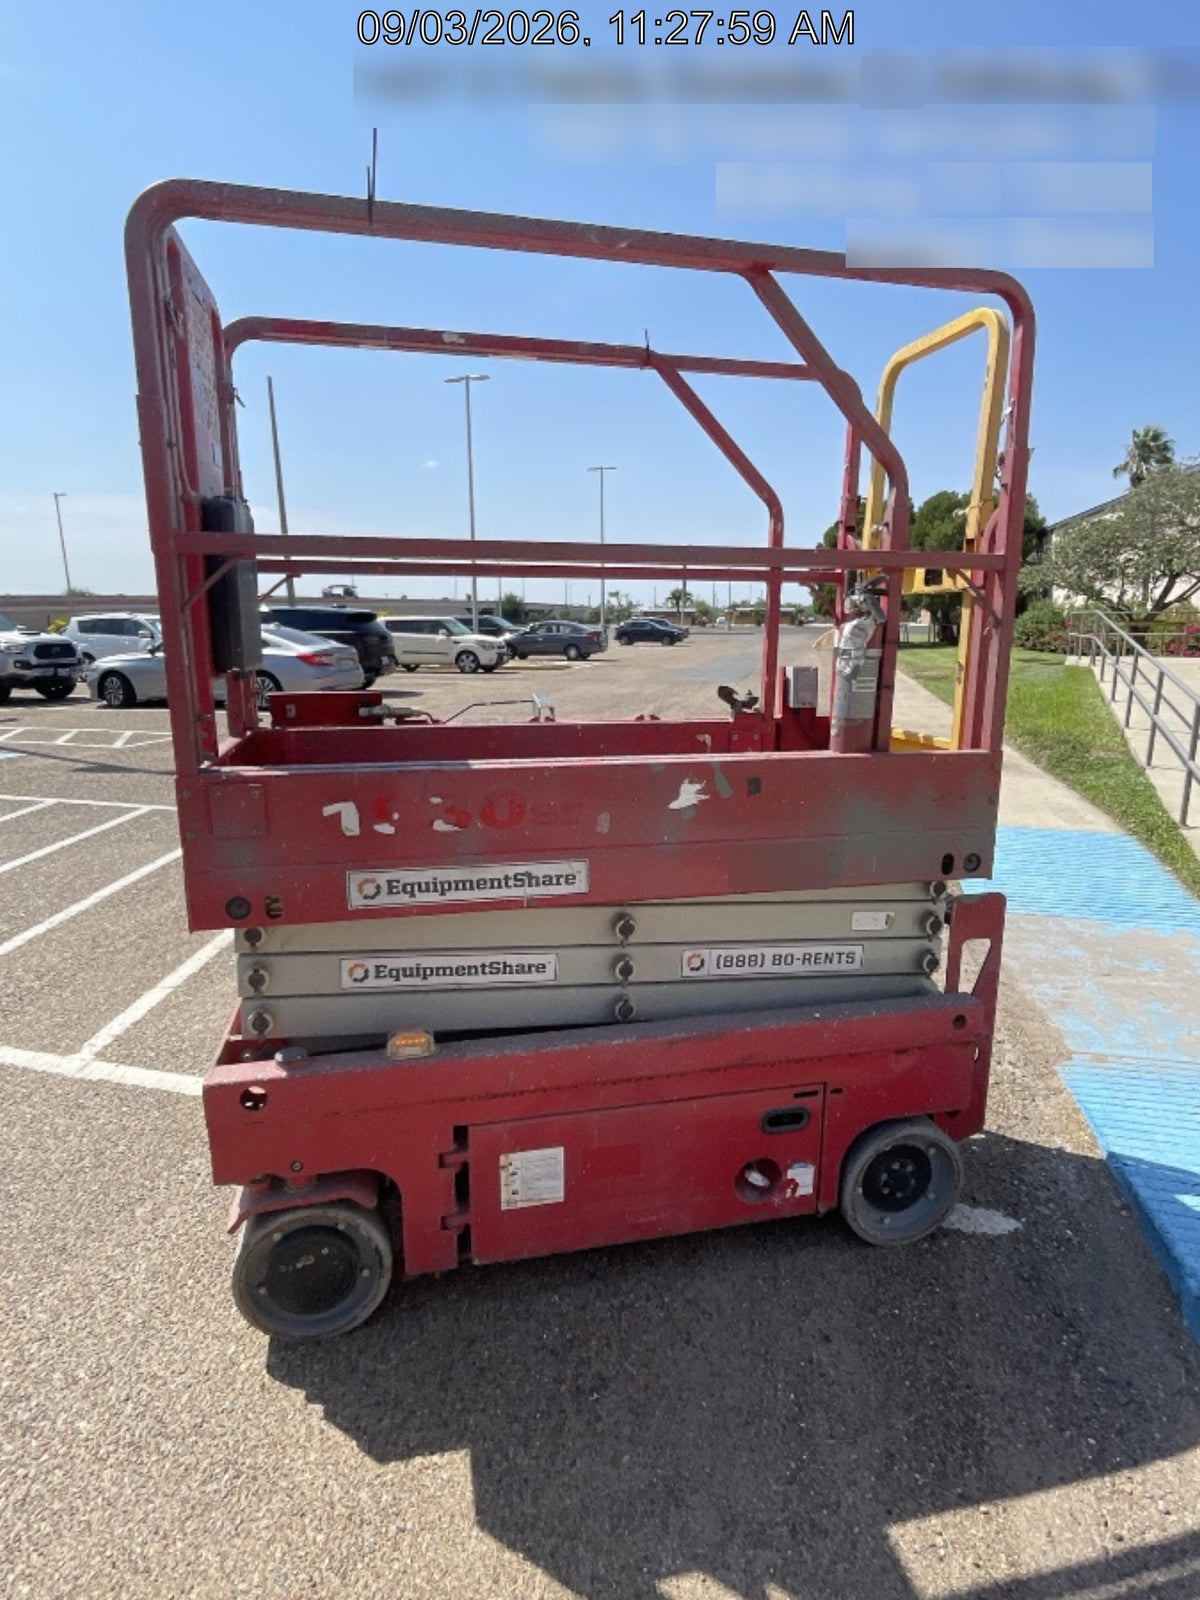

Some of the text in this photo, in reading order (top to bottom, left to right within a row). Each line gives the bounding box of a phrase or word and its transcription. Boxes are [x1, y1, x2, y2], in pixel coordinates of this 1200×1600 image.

[386, 870, 577, 898] EquipmentShare
[374, 960, 547, 982] EquipmentShare
[716, 951, 857, 969] (888) 80-RENTS
